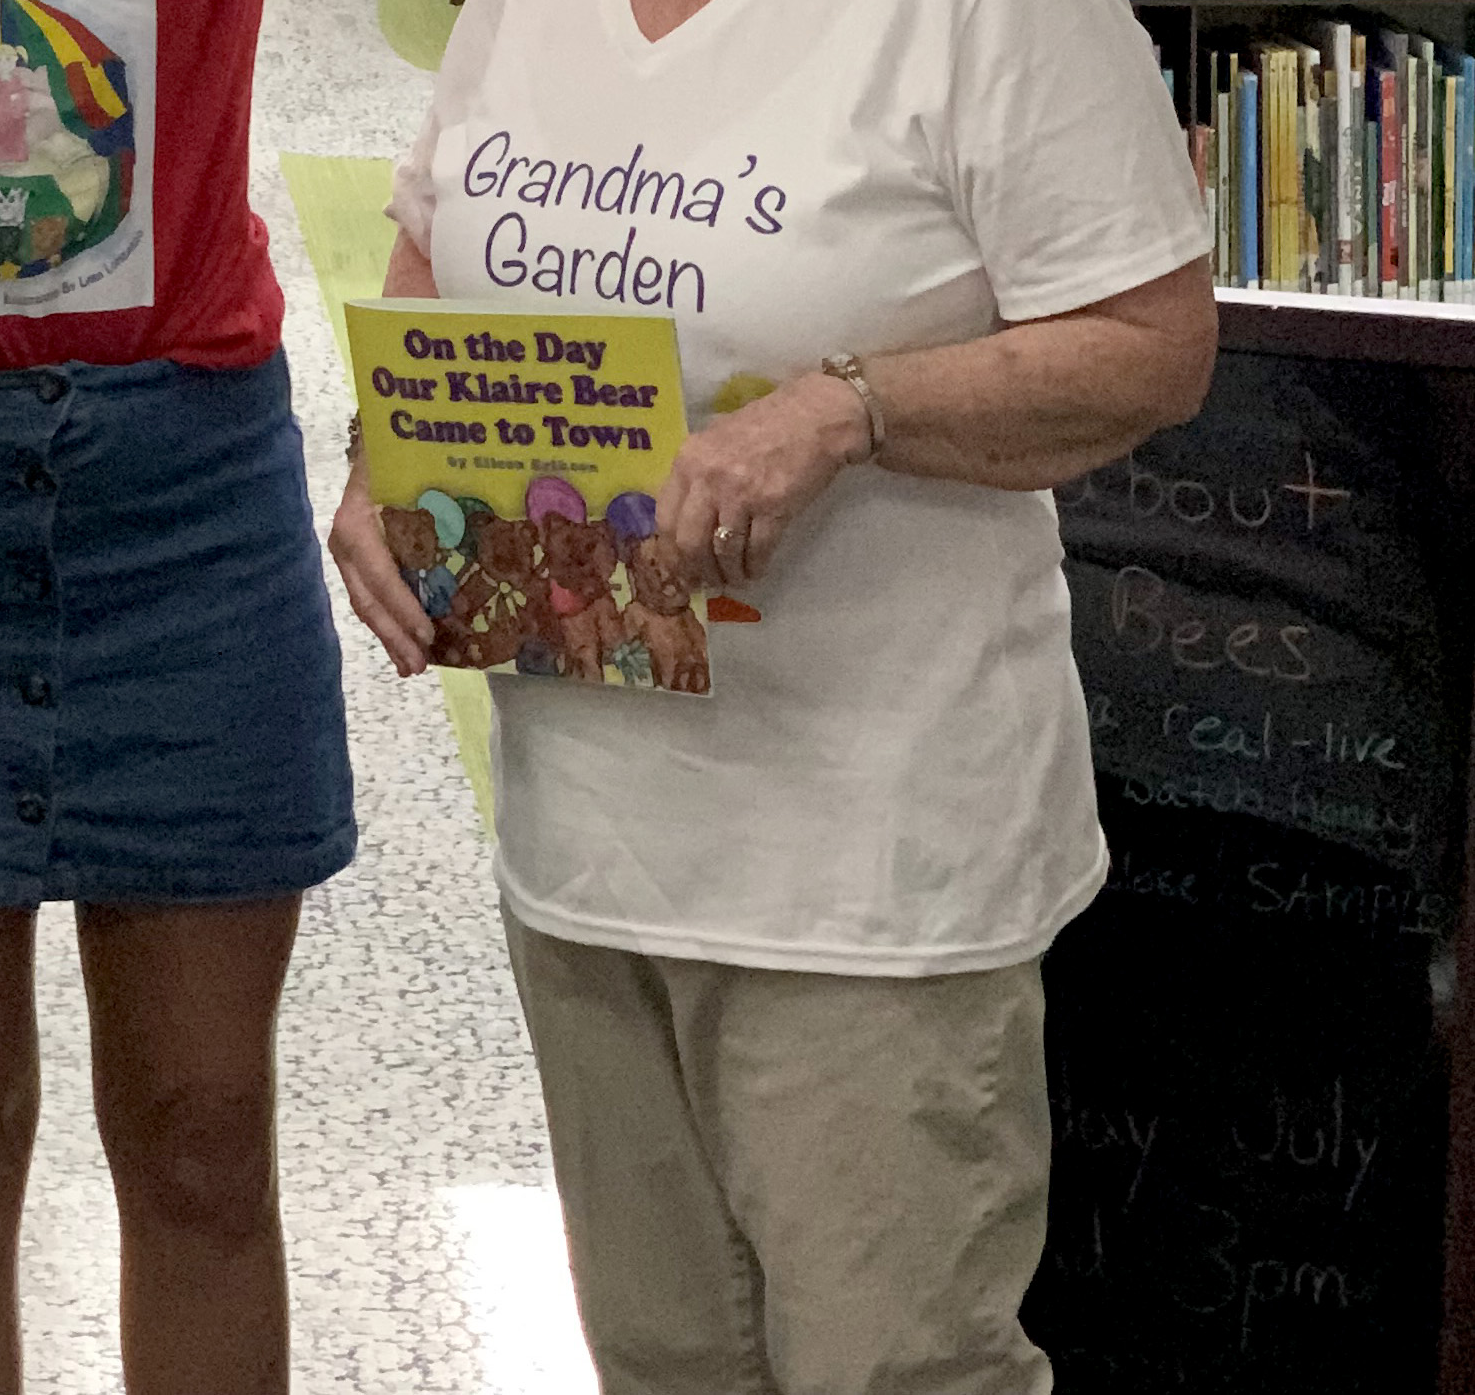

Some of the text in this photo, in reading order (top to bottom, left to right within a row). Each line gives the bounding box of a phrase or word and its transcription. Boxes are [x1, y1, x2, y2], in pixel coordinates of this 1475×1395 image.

[464, 131, 786, 235] Grandma's
[486, 212, 705, 313] Garden
[371, 366, 659, 408] Our Klaire Bear
[404, 329, 607, 371] On the Day
[390, 410, 653, 450] Came to Town
[1111, 565, 1309, 680] Bees
[1231, 1075, 1379, 1213] July
